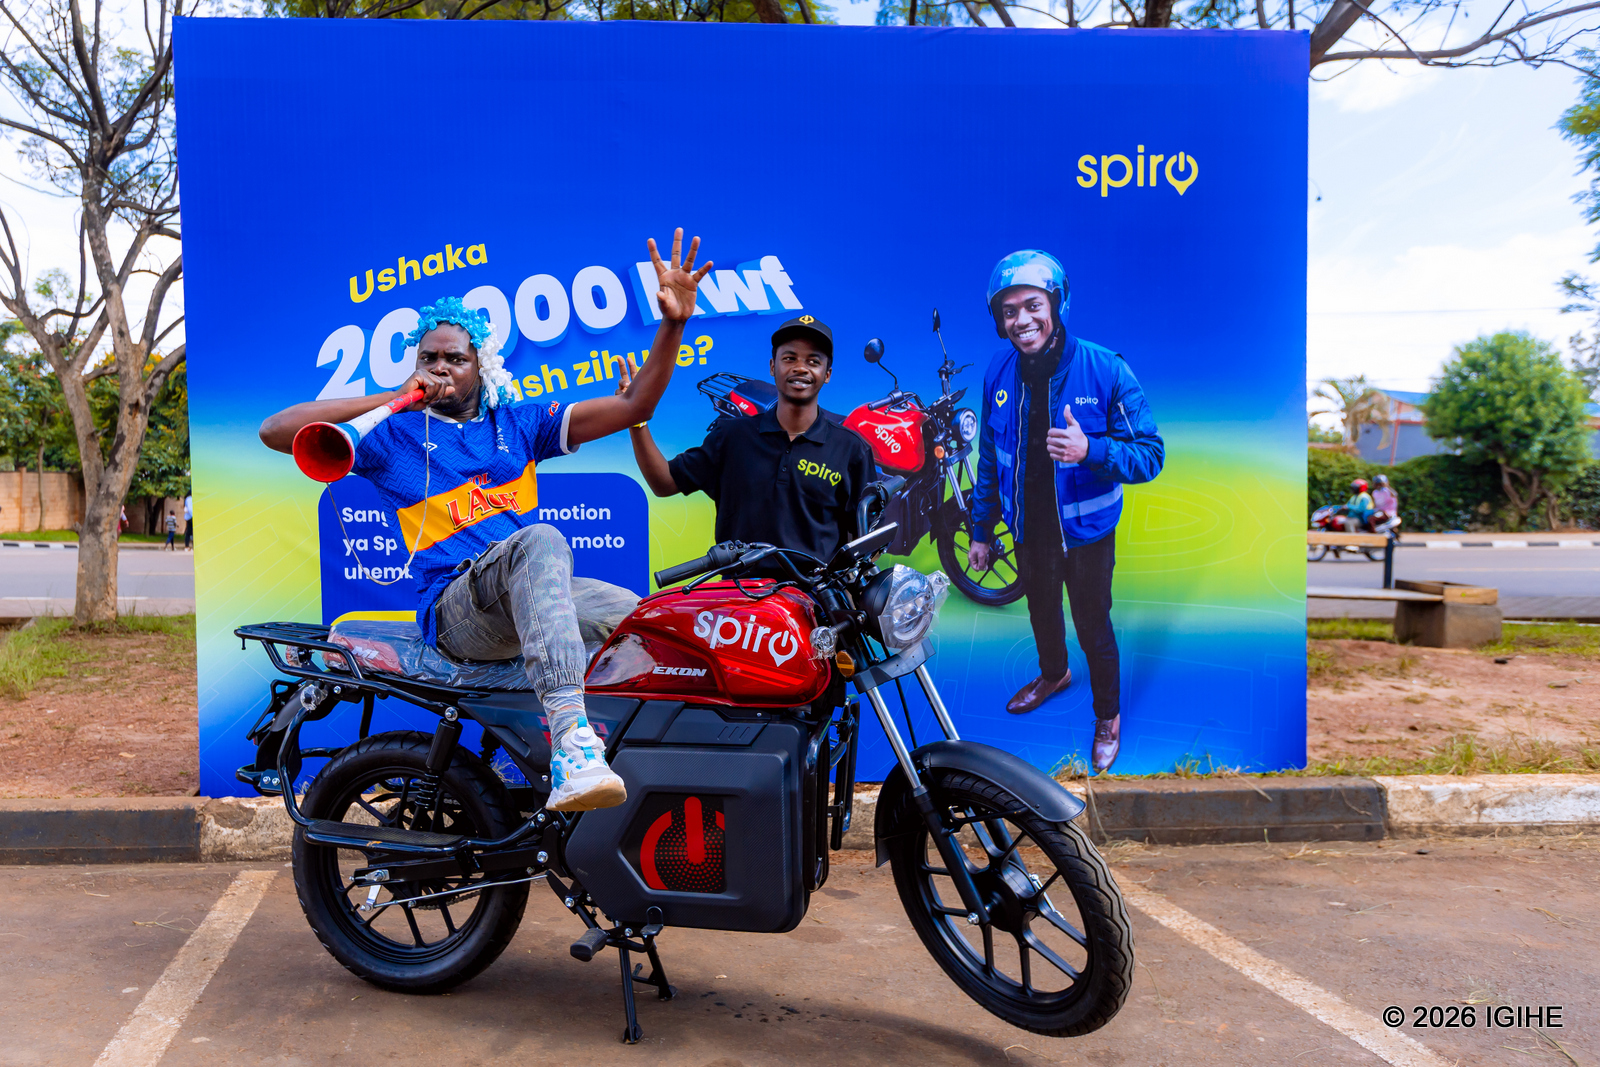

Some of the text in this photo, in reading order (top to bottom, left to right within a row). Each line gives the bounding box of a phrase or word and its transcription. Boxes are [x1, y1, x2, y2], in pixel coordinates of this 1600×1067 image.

[1076, 144, 1199, 197] spiro
[349, 243, 488, 303] Ushaka
[573, 335, 714, 386] zihue?
[1075, 395, 1099, 406] spiro
[874, 425, 901, 453] spiro
[797, 459, 842, 487] spiro
[342, 538, 368, 556] ya
[572, 534, 625, 549] moto
[693, 611, 798, 667] spiro
[652, 666, 707, 677] EKON
